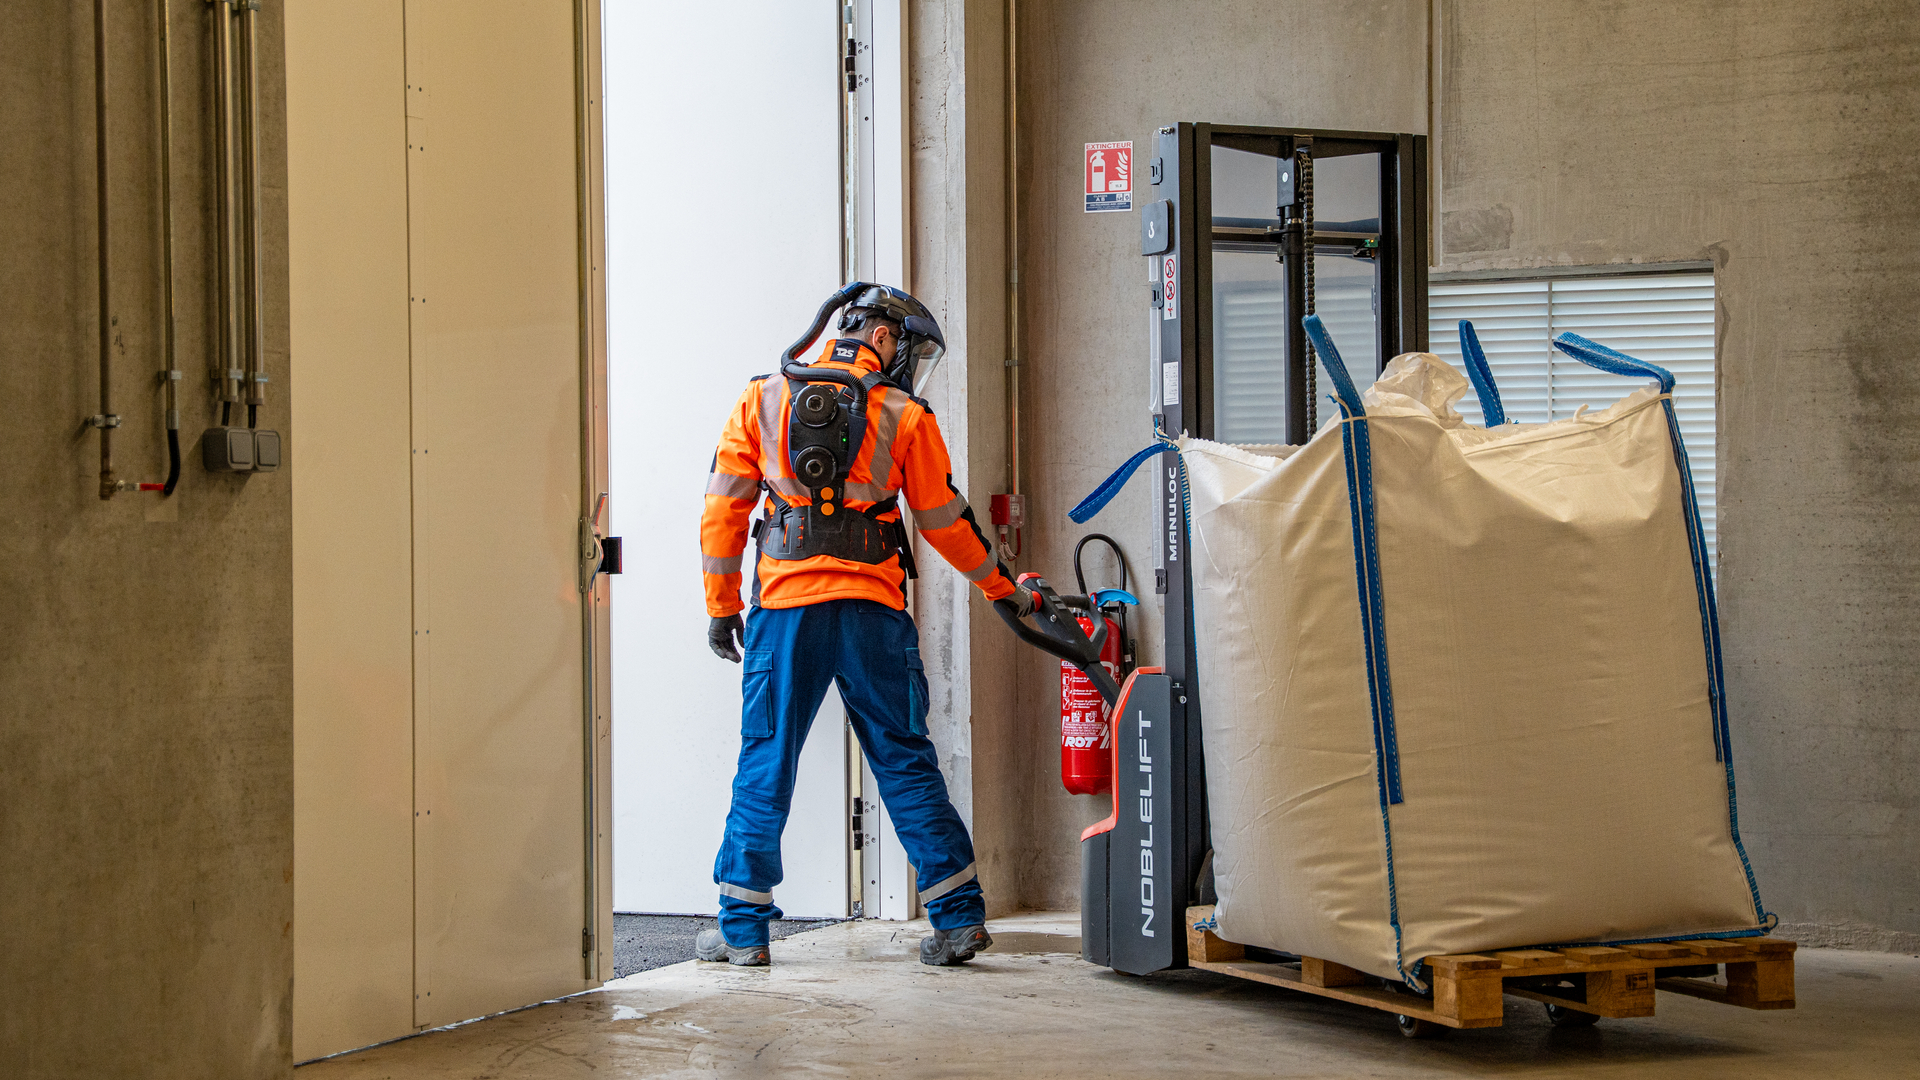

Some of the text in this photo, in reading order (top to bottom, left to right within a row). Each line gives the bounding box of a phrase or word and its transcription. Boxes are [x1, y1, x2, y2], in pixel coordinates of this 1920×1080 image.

[1086, 142, 1131, 150] EXTINCTEUR
[836, 347, 855, 358] T2S
[1168, 467, 1178, 561] MANULOC
[1138, 710, 1155, 938] NOBLELIFT
